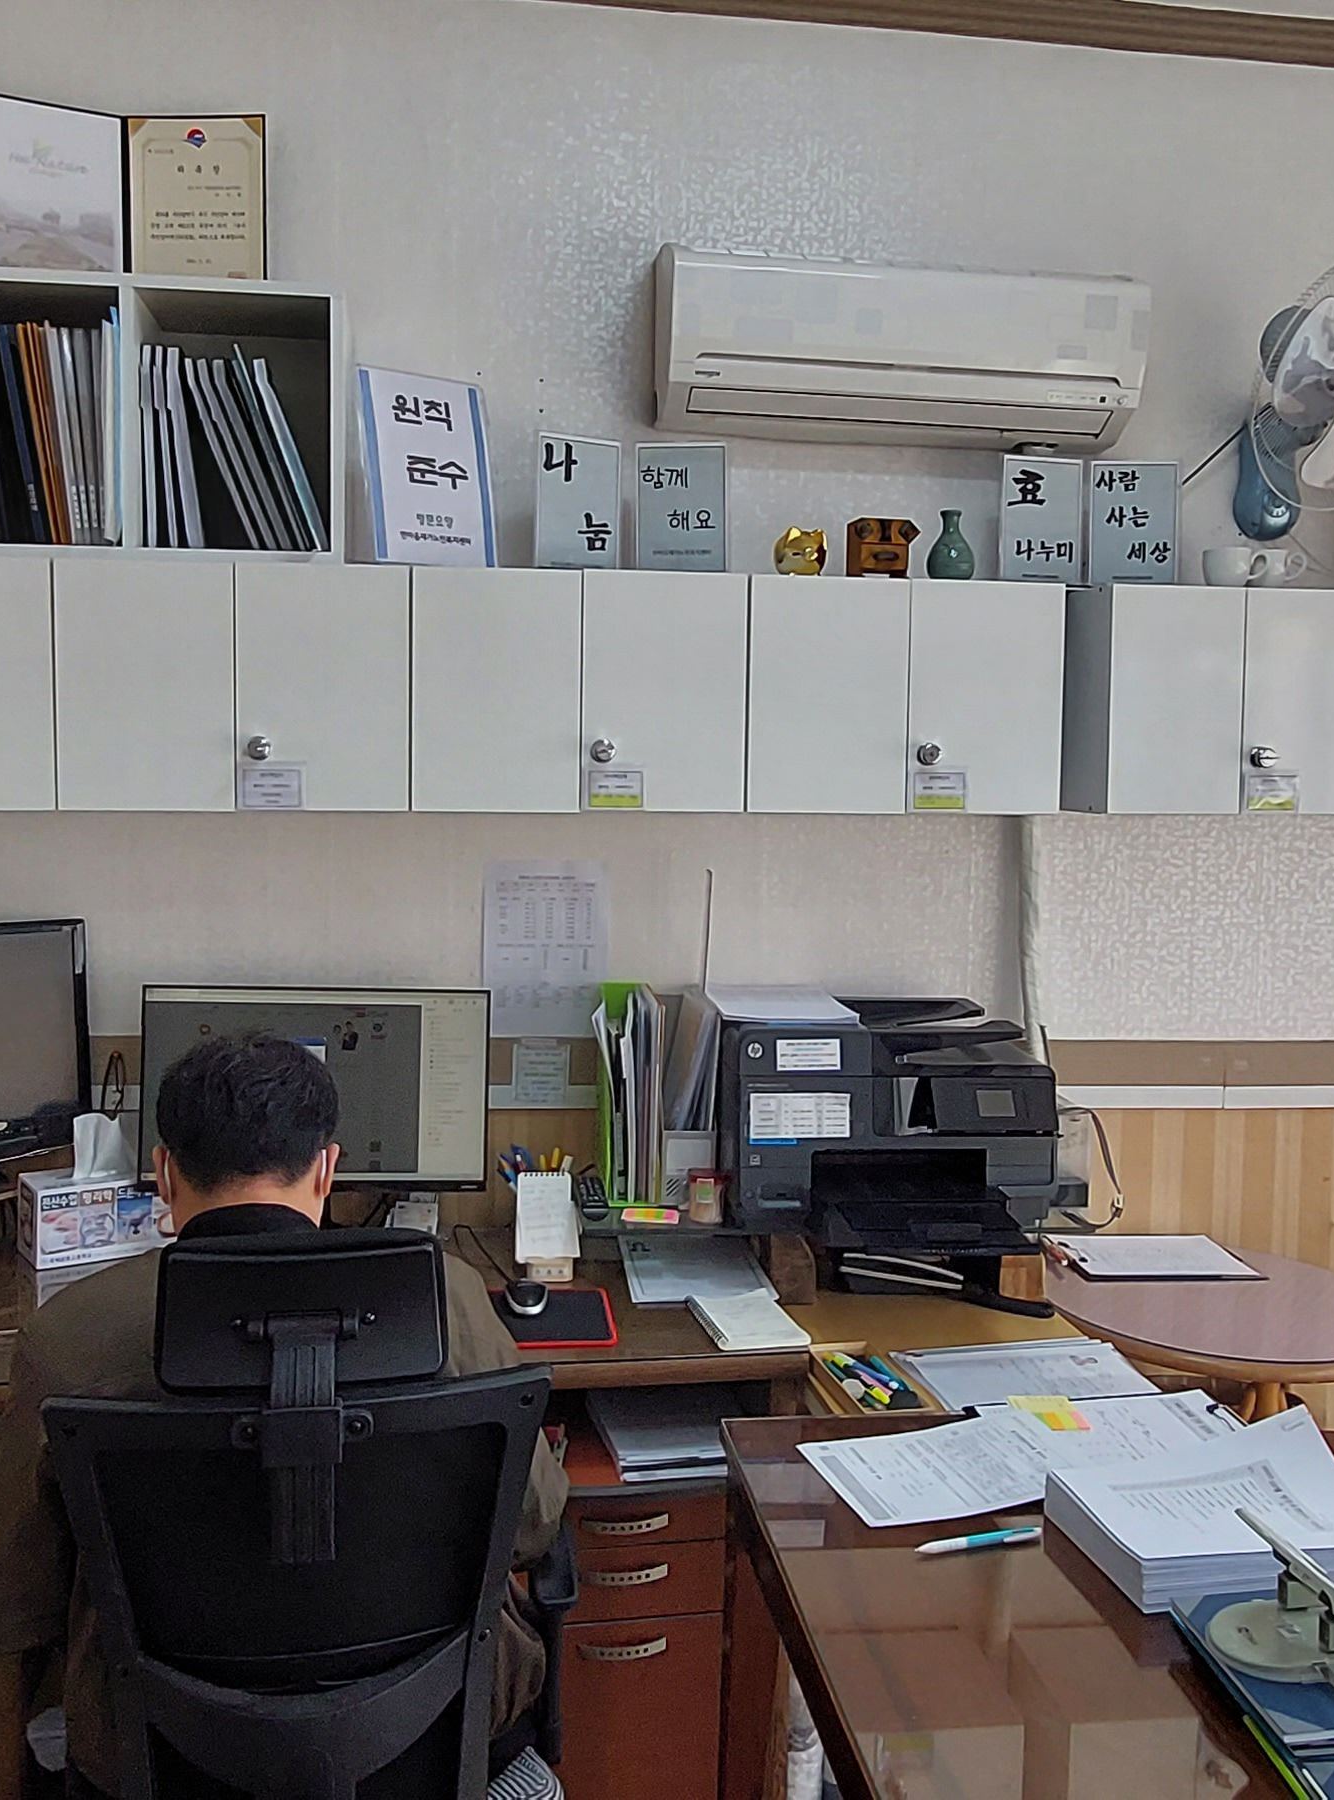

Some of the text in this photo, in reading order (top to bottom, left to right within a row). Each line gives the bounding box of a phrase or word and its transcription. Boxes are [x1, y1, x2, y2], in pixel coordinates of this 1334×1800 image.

[391, 394, 453, 432] 원칙
[406, 454, 469, 490] 준수
[543, 442, 578, 482] 나
[640, 465, 689, 489] 함께
[1006, 469, 1046, 508] 효
[1095, 469, 1140, 492] 사람
[668, 509, 716, 532] 해요
[1105, 504, 1151, 528] 사는
[577, 512, 612, 551] 눔
[1016, 539, 1074, 564] 나누미
[1127, 540, 1171, 564] 세상
